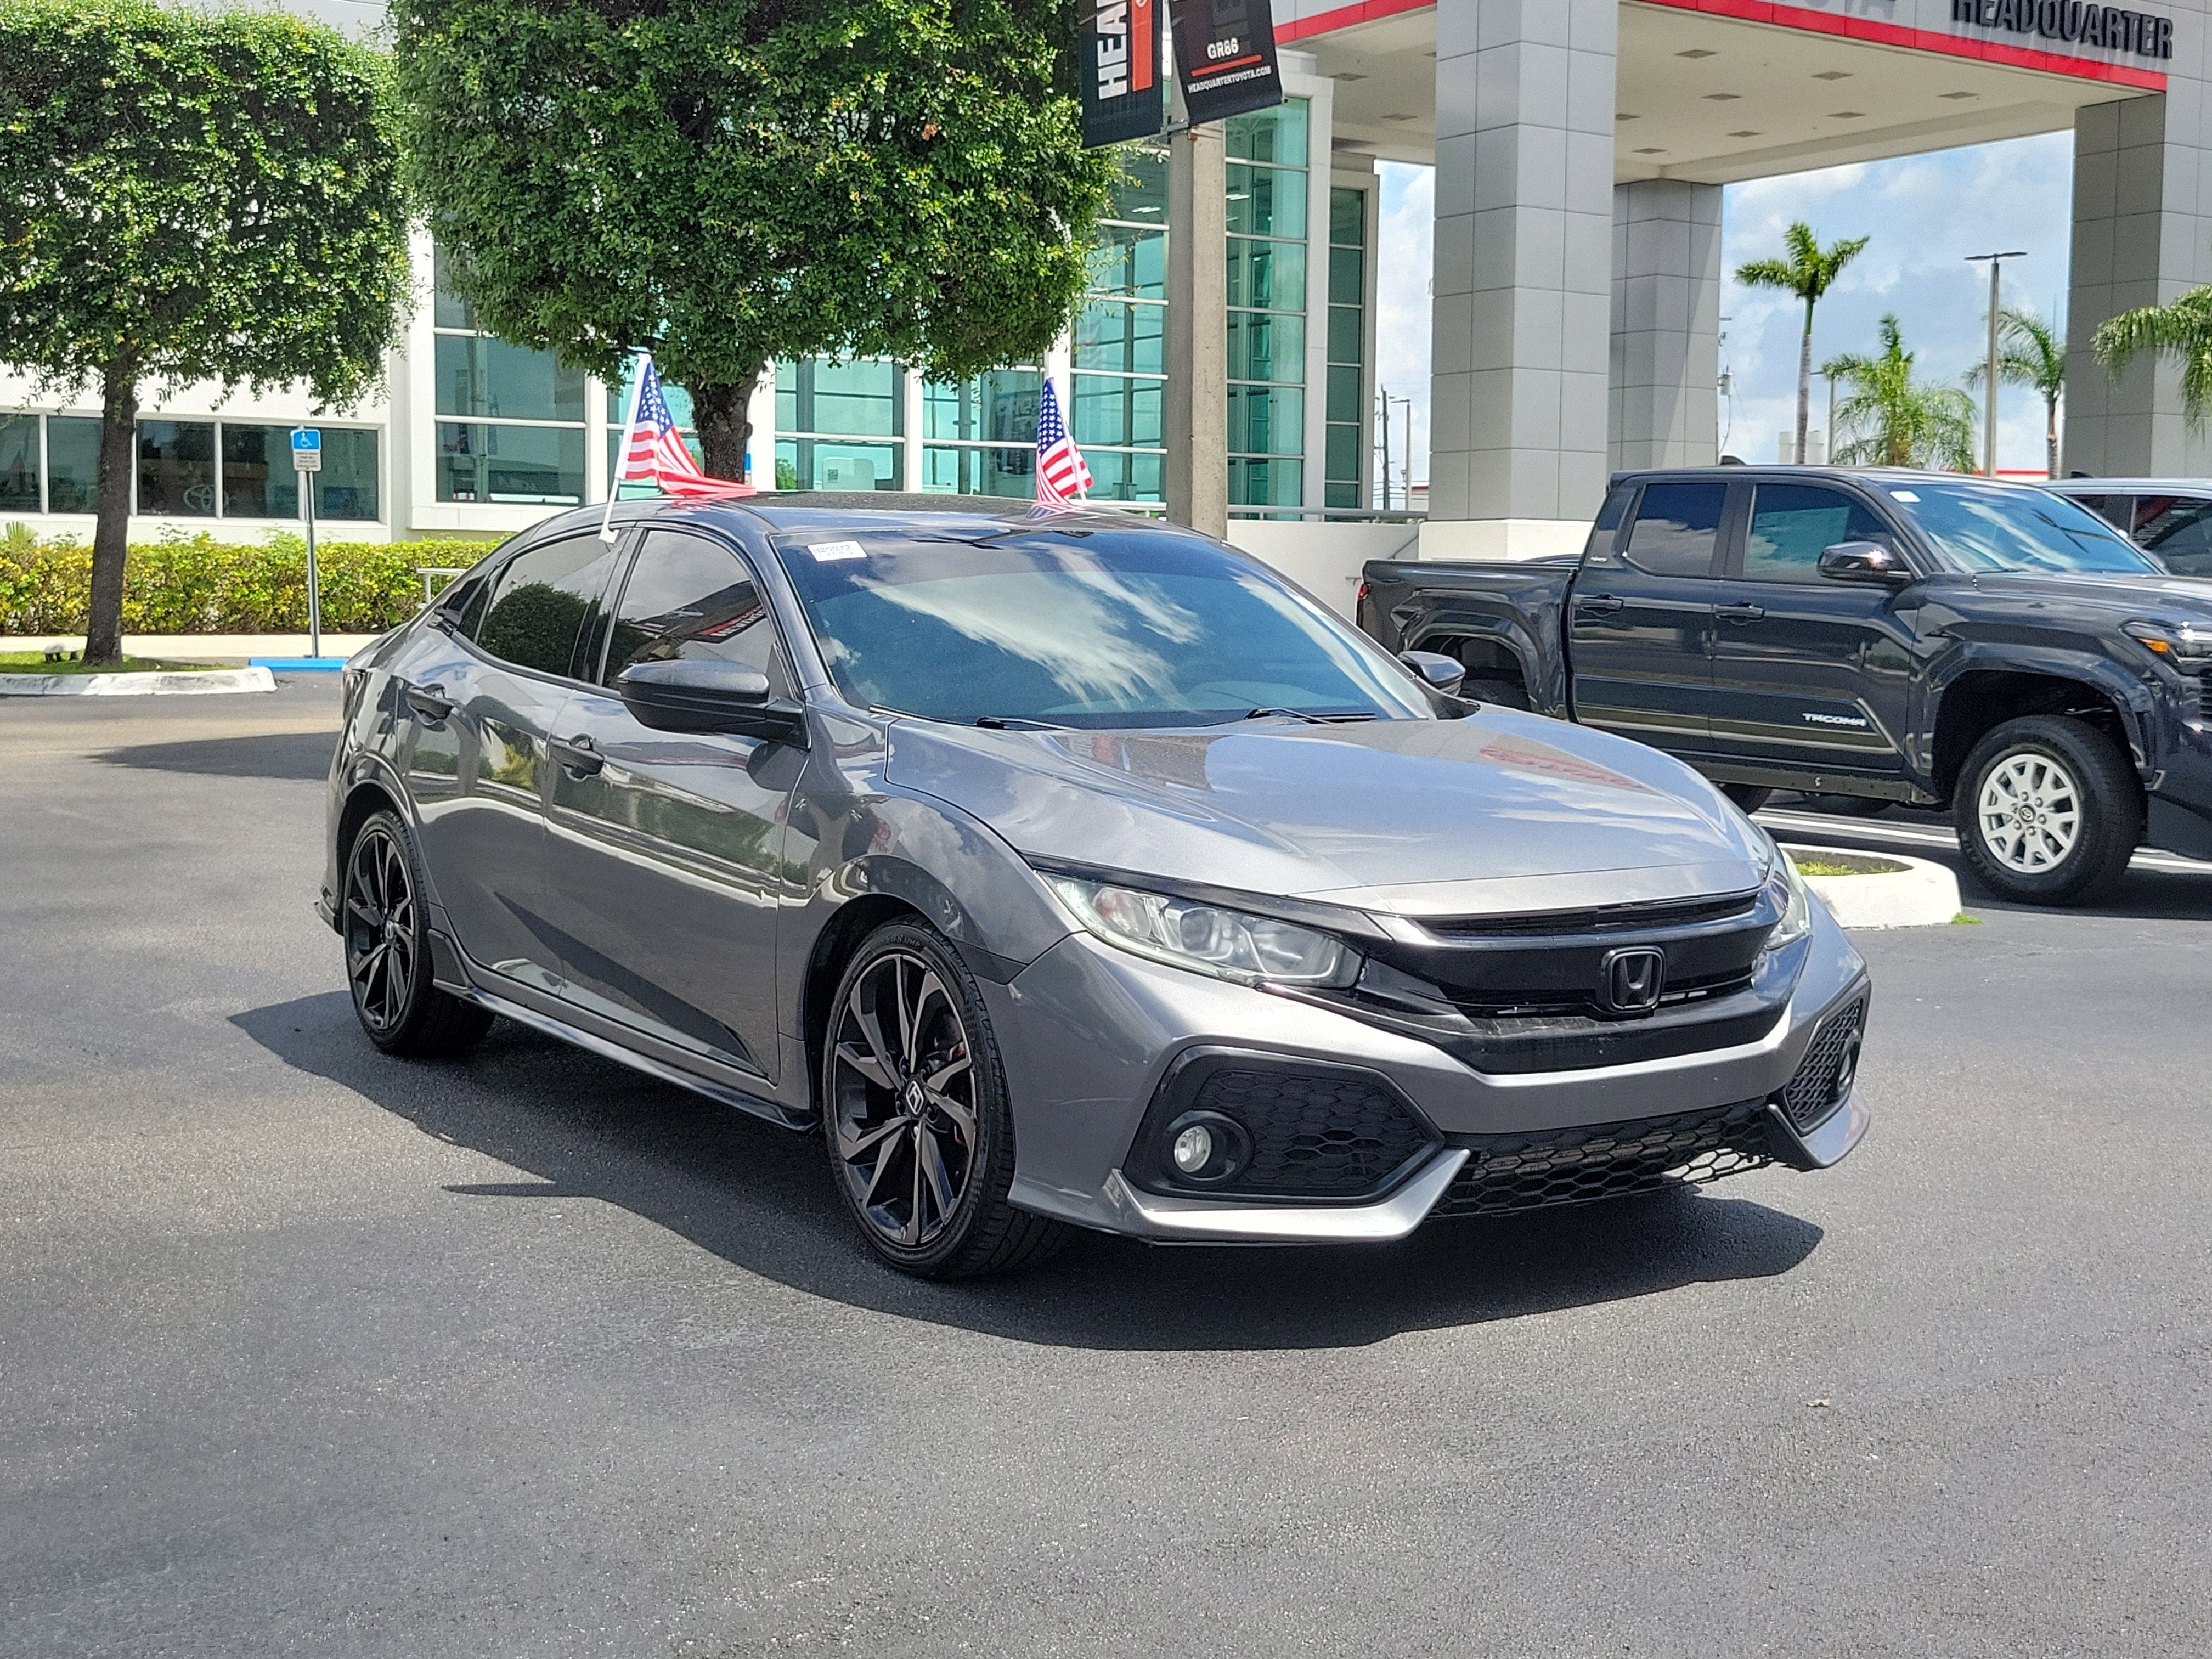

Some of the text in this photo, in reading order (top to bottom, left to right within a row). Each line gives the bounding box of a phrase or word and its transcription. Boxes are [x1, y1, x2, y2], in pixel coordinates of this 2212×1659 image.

[1207, 37, 1239, 59] GR86
[1187, 65, 1272, 94] HEADQUARTERTOYOTA.COM
[1802, 713, 1866, 727] TACOMA
